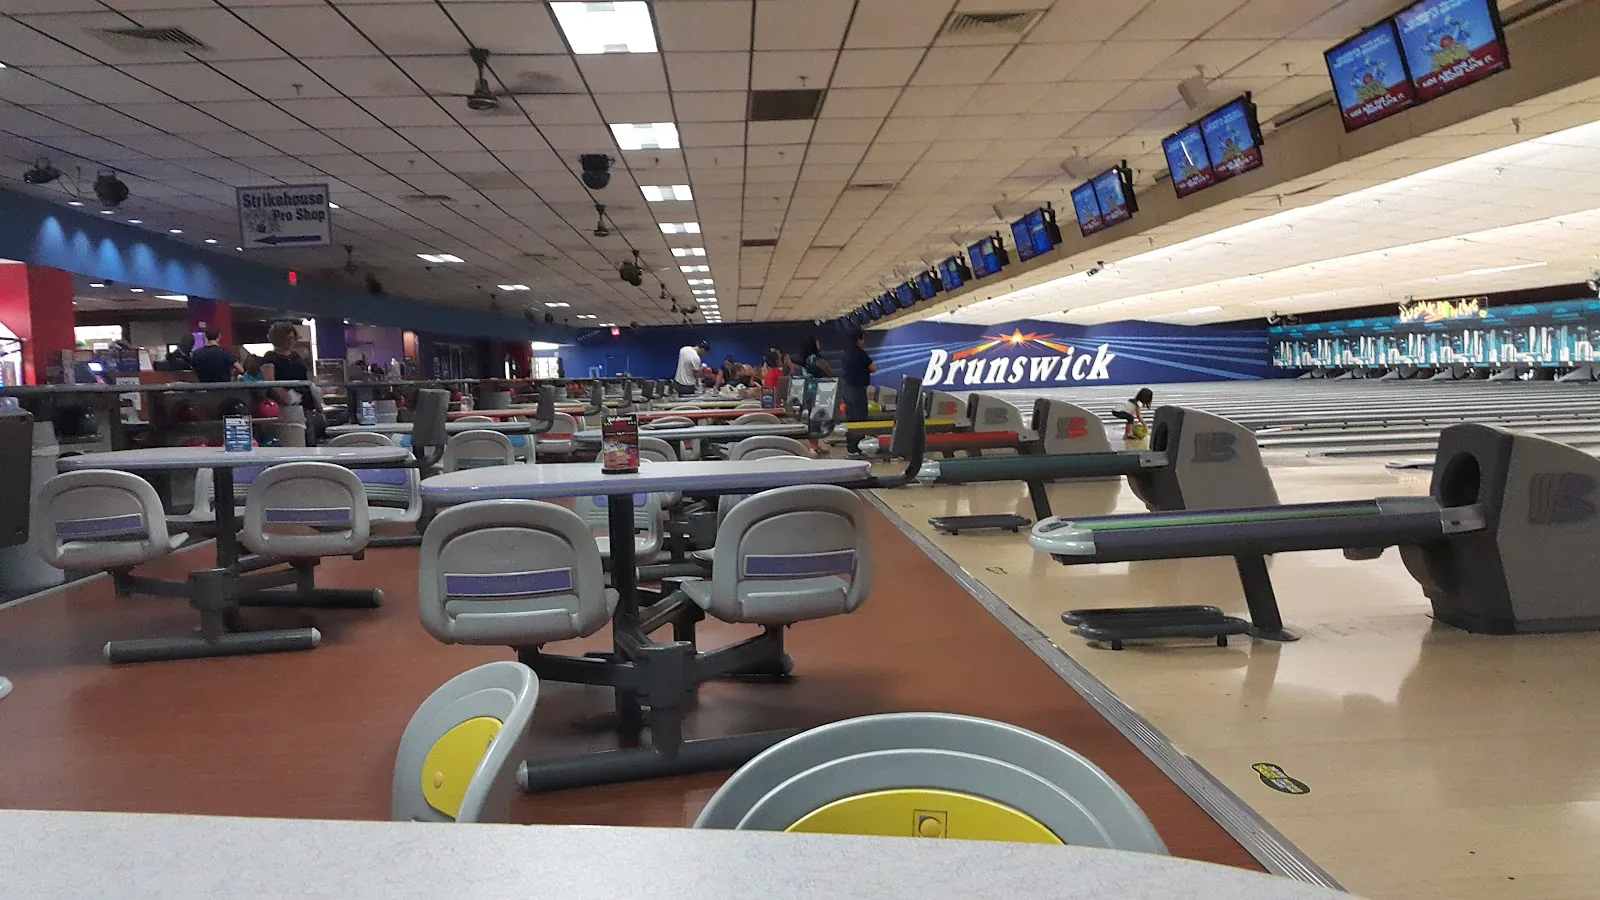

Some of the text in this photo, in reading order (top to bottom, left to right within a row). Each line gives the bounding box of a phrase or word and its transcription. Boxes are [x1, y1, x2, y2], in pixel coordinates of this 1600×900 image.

[242, 192, 324, 208] Strikehouse
[272, 207, 325, 223] Pro Shop
[922, 343, 1116, 386] Brunswick
